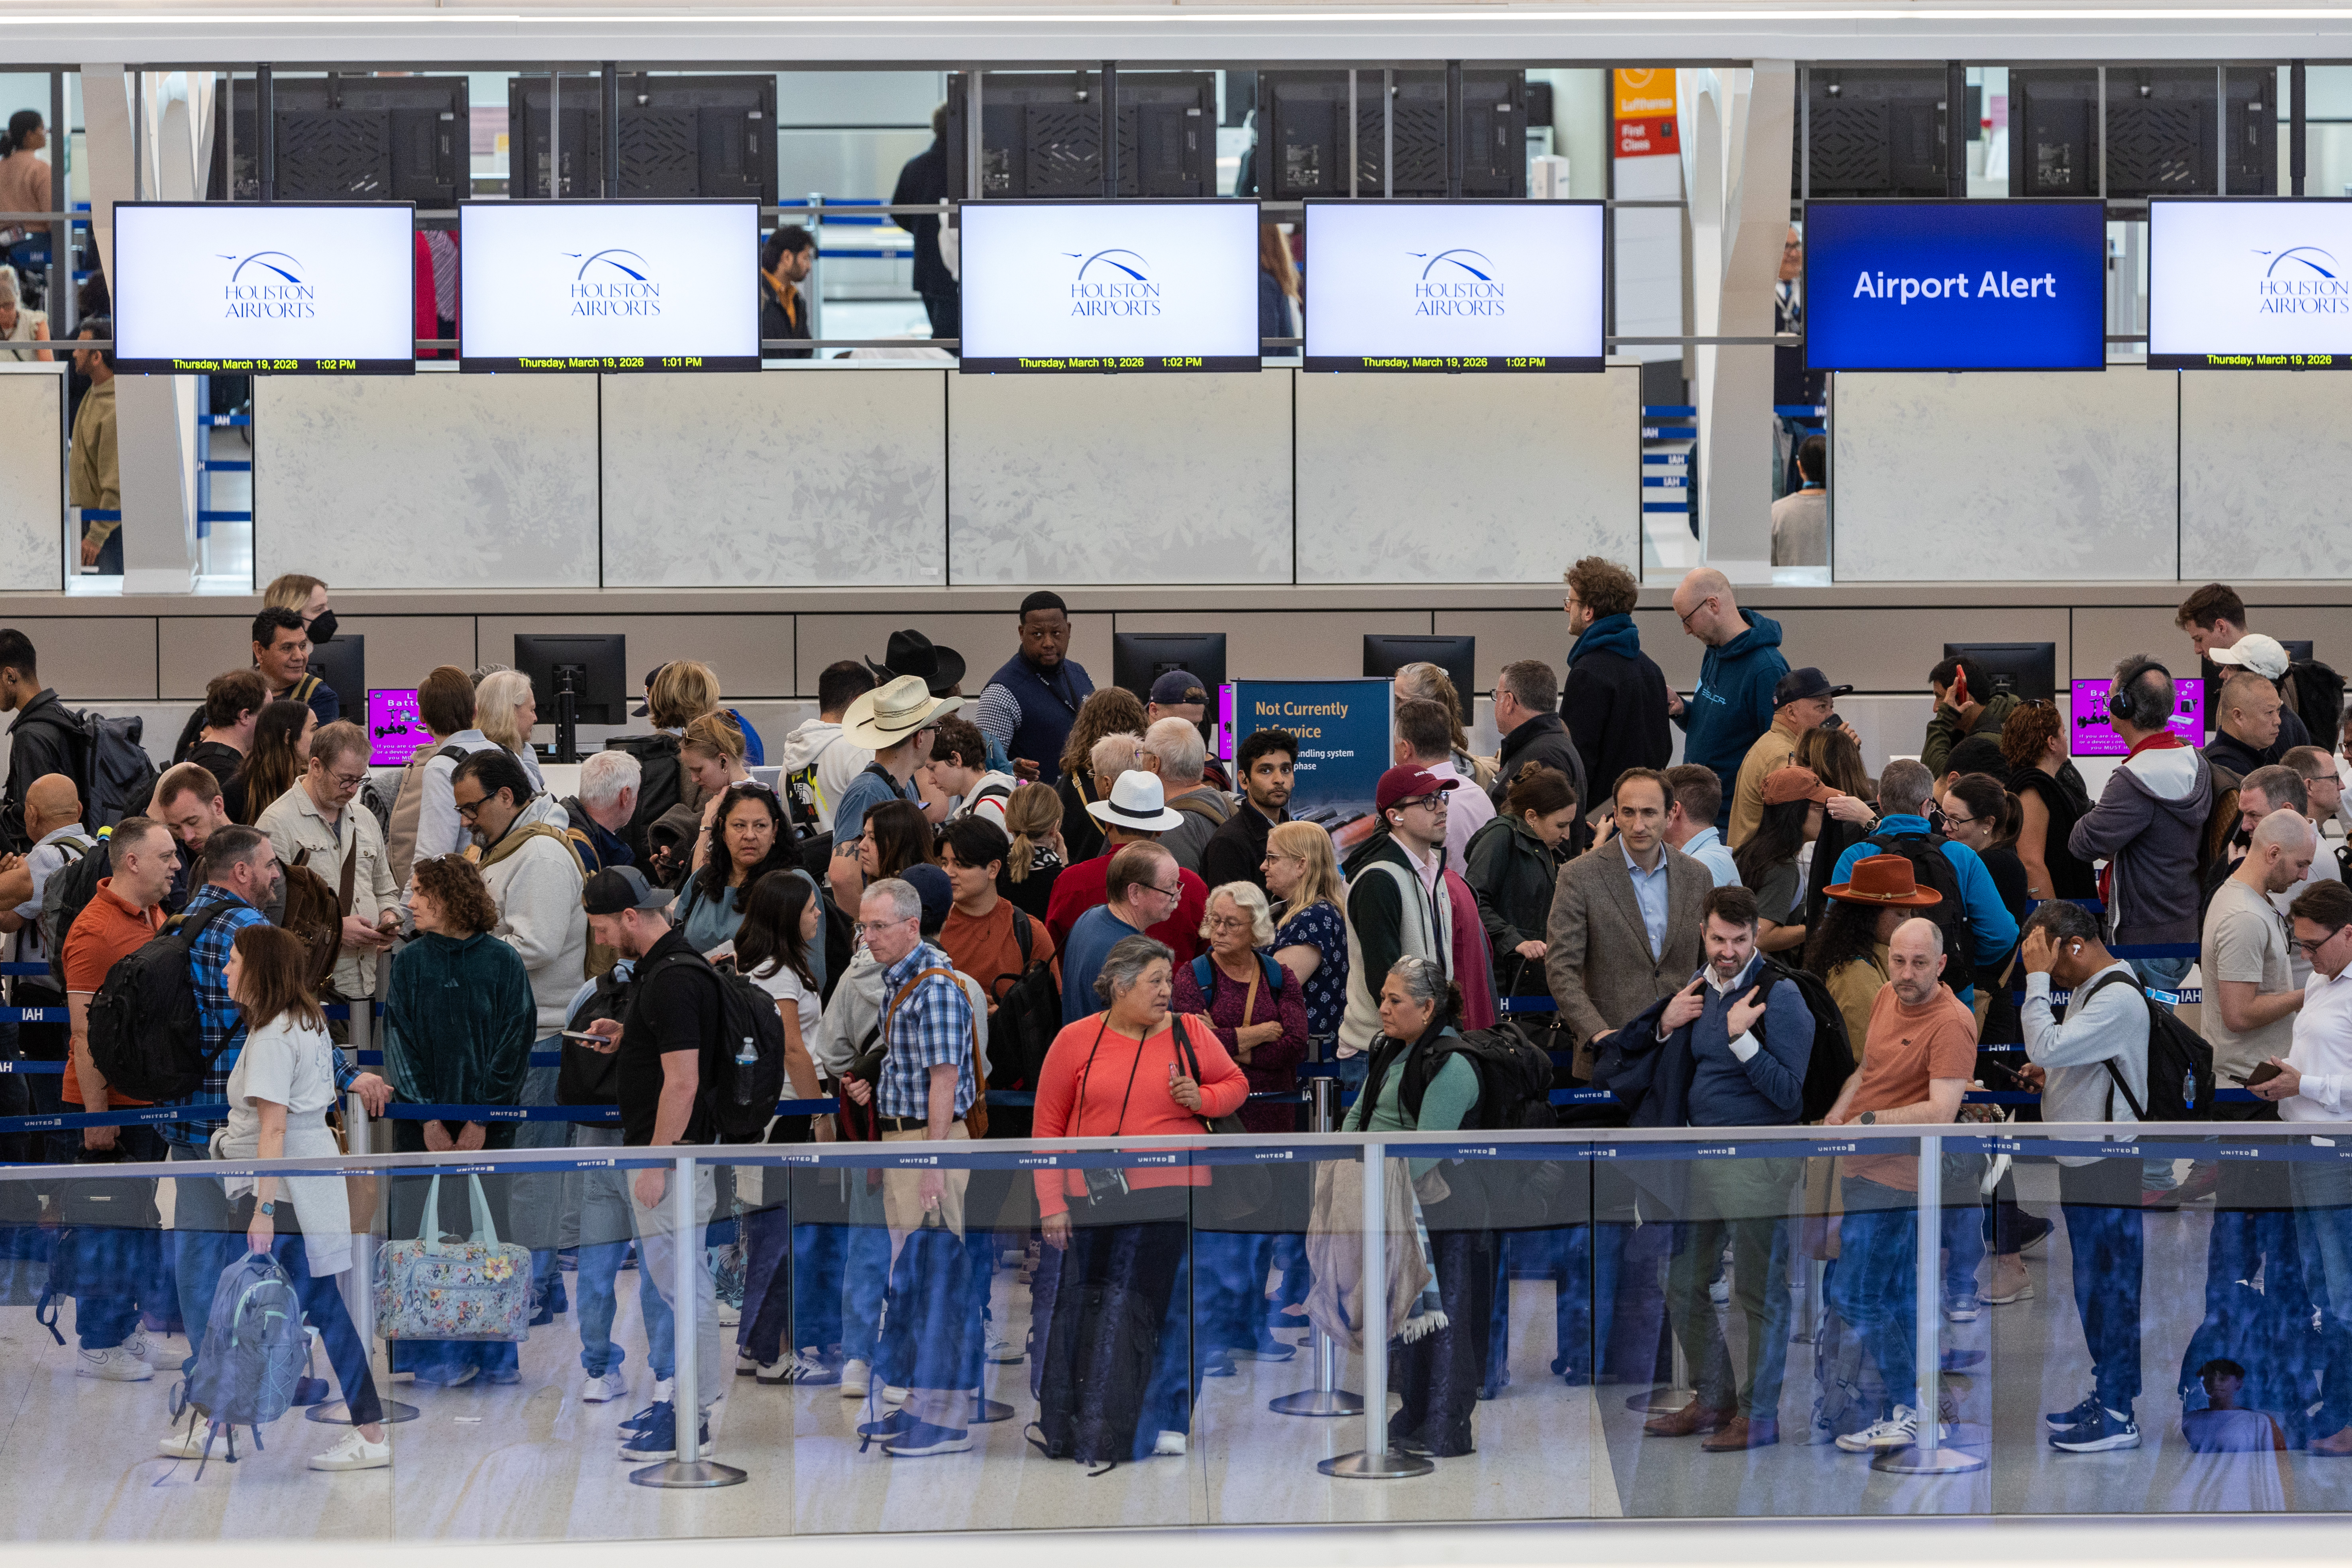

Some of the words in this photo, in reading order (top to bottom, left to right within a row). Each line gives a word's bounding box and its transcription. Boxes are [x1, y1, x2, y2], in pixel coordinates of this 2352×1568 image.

[226, 286, 313, 299] HOUSTON
[572, 284, 659, 297] HOUSTON
[1072, 283, 1159, 297] HOUSTON
[1416, 283, 1504, 297] HOUSTON
[1854, 272, 1968, 305] Airport
[1978, 271, 2056, 298] Alert
[2261, 281, 2348, 294] HOUSTON
[226, 302, 314, 318] AIRPORTS
[571, 300, 660, 316] AIRPORTS
[1072, 300, 1160, 316] AIRPORTS
[1415, 300, 1504, 316] AIRPORTS
[2260, 298, 2348, 313] AIRPORTS
[173, 359, 220, 371] Thursday,
[223, 360, 253, 369] March
[257, 360, 270, 370] 19,
[274, 360, 298, 369] 2026
[316, 360, 336, 369] 1:02
[340, 360, 355, 369] PM
[519, 358, 565, 369] Thursday,
[569, 358, 599, 367] March
[603, 358, 616, 368] 19,
[620, 357, 644, 367] 2026
[662, 357, 681, 367] 1:01
[686, 357, 701, 366] PM
[1019, 358, 1066, 369] Thursday,
[1069, 358, 1099, 367] March
[1103, 358, 1117, 368] 19,
[1120, 358, 1144, 367] 2026
[1162, 357, 1183, 367] 1:02
[1186, 357, 1202, 366] PM
[1363, 357, 1409, 369] Thursday,
[1413, 357, 1442, 367] March
[1446, 358, 1460, 367] 19,
[1463, 358, 1487, 367] 2026
[1506, 358, 1526, 367] 1:02
[1529, 358, 1545, 367] PM
[2207, 355, 2254, 366] Thursday,
[2257, 355, 2287, 364] March
[2291, 355, 2304, 365] 19,
[2308, 355, 2332, 364] 2026
[1256, 702, 1280, 715] Not
[1284, 702, 1348, 718] Currently
[1327, 750, 1354, 759] system
[1294, 762, 1316, 771] phase
[2181, 990, 2201, 1002] IAH
[22, 1008, 43, 1020] IAH
[1302, 1090, 1312, 1101] IA
